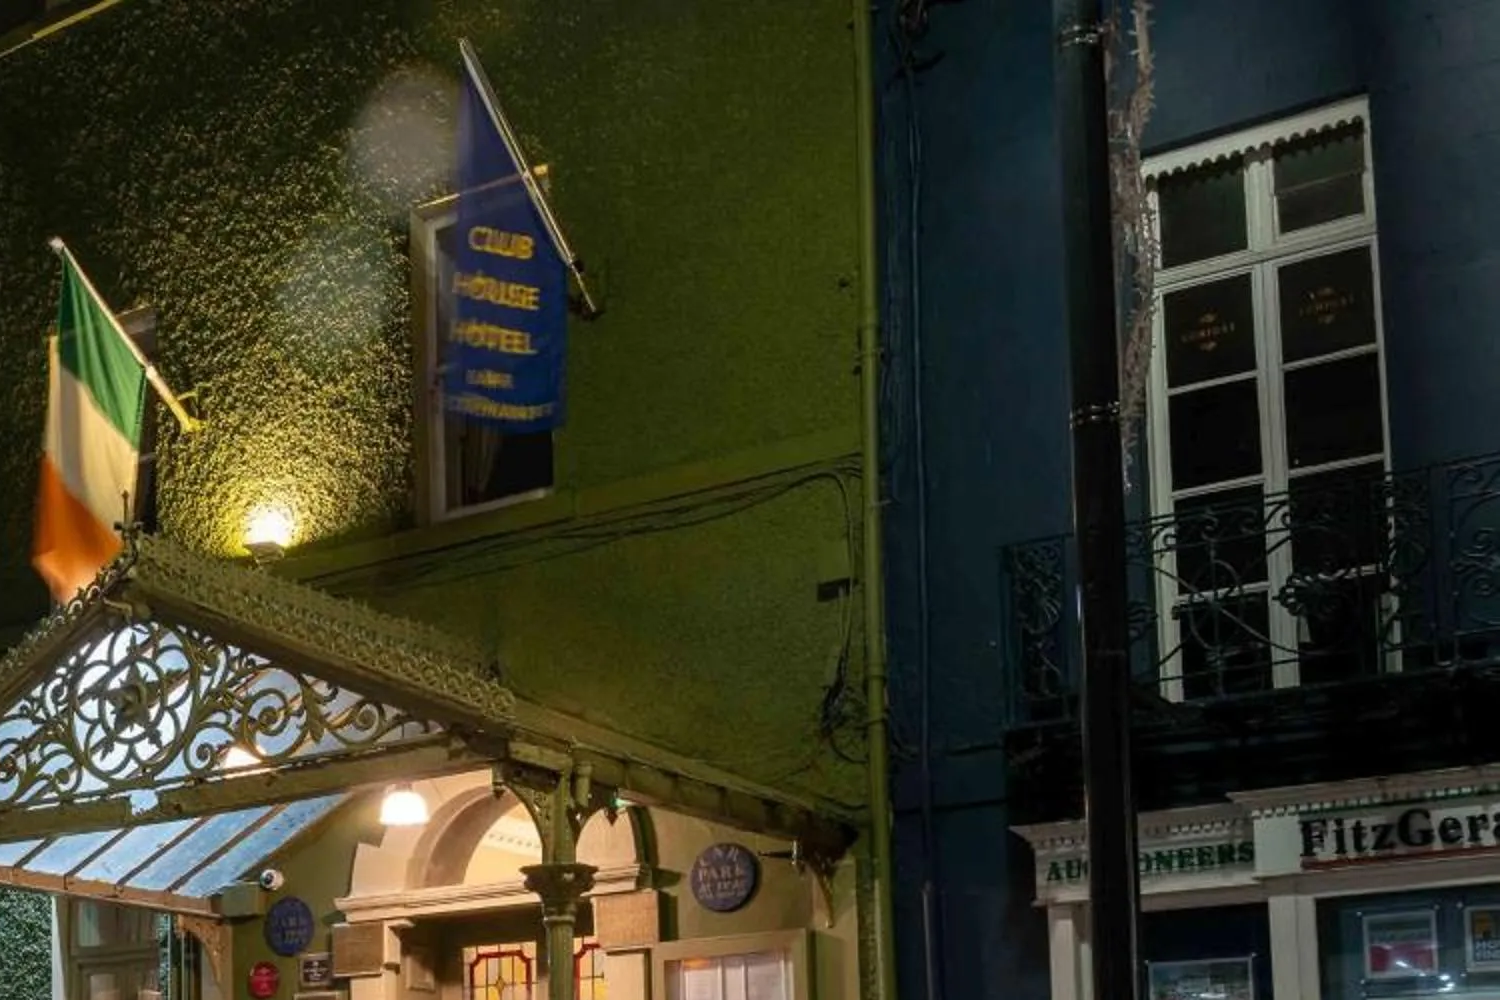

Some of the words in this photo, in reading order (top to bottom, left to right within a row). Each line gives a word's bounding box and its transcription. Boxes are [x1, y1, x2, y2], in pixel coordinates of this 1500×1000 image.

[468, 226, 535, 260] CLUB
[452, 270, 541, 311] HOUSE
[1046, 842, 1254, 882] AUONEERS
